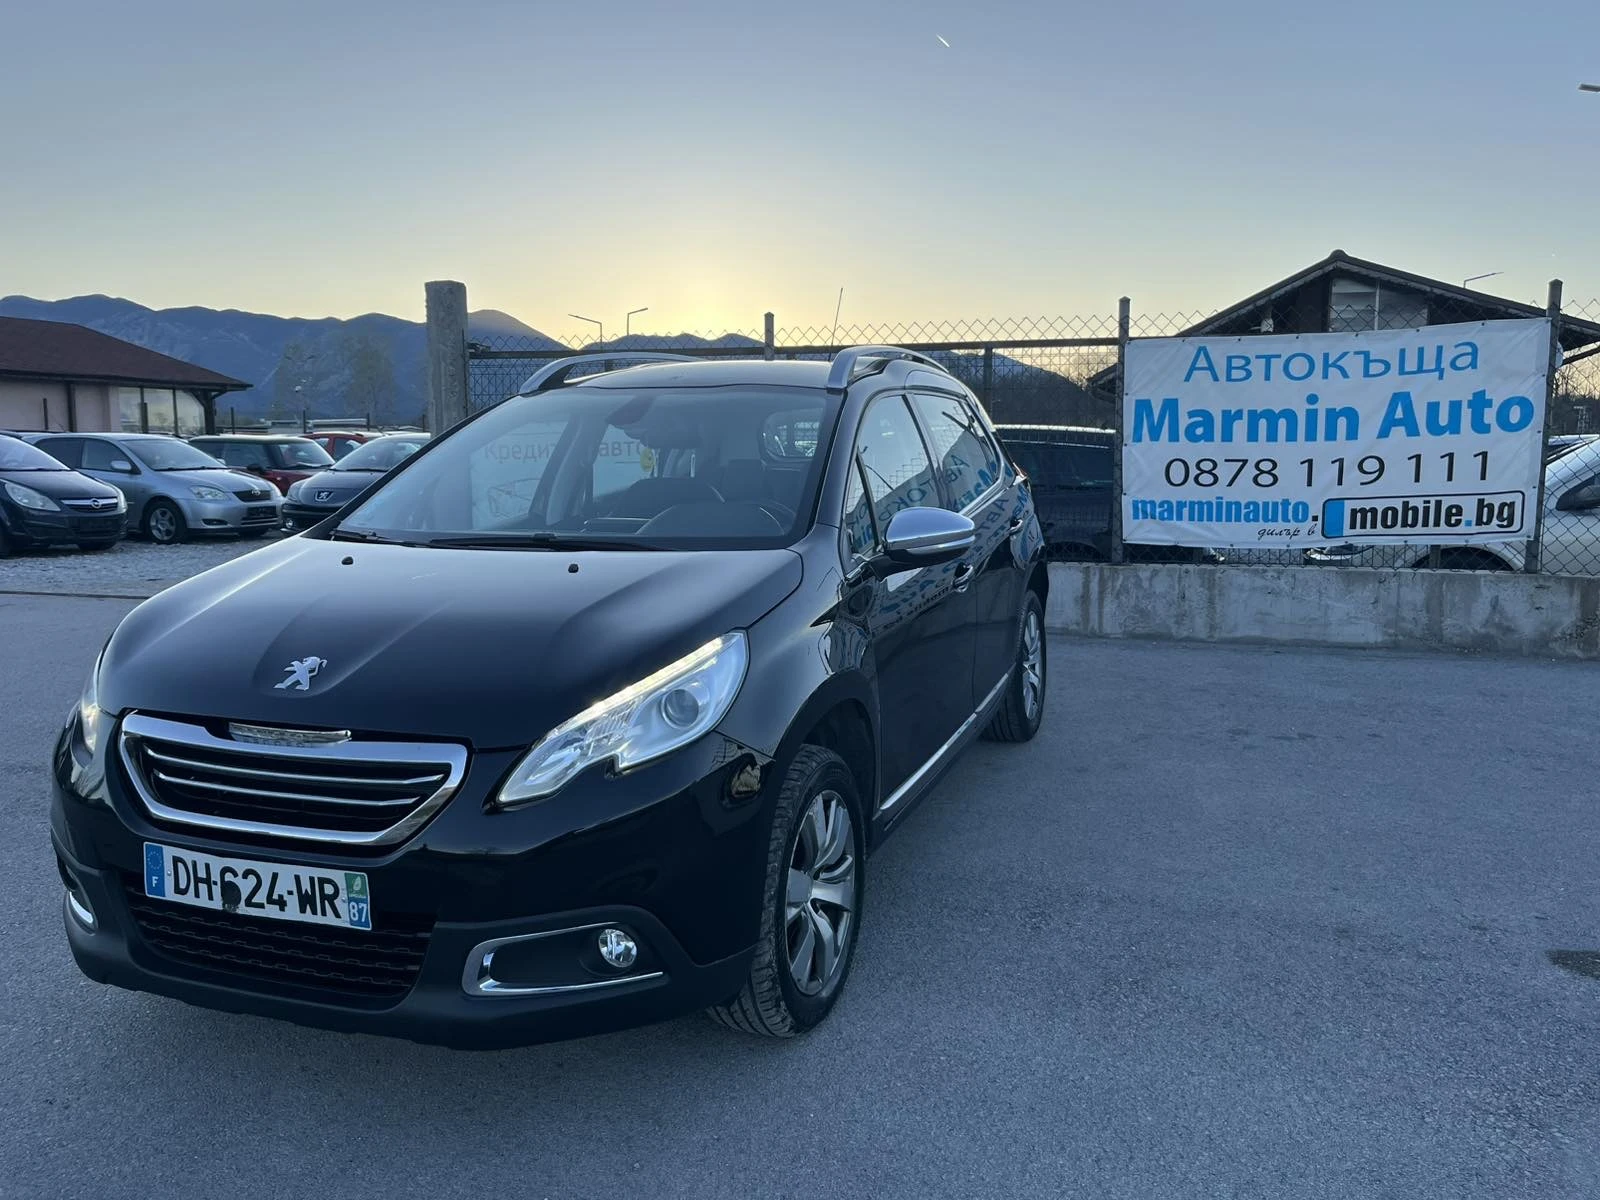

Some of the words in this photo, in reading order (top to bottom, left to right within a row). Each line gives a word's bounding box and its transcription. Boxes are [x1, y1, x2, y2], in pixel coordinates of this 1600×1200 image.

[1183, 341, 1479, 383] Автокъща
[1131, 394, 1360, 443] Marmin
[1375, 389, 1535, 440] Auto
[1163, 457, 1279, 488] 0878
[1299, 454, 1386, 487] 119
[1406, 450, 1489, 484] 111
[1348, 498, 1516, 529] mobile.bg
[152, 876, 159, 887] F
[349, 901, 367, 923] 87
